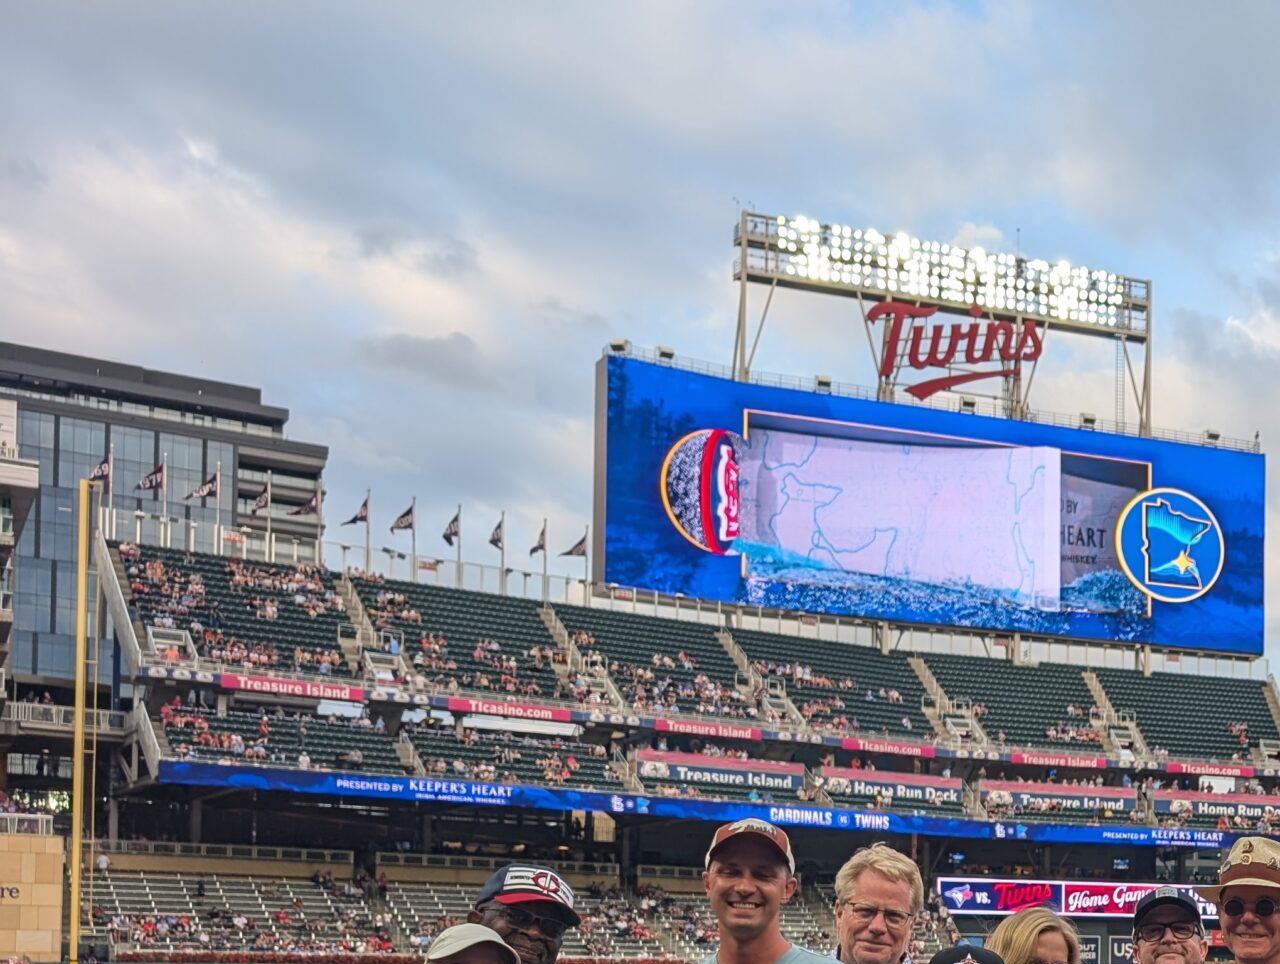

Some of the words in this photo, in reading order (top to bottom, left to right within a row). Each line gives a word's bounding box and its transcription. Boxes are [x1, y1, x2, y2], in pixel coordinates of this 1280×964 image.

[867, 302, 1043, 377] Twins
[1066, 499, 1079, 514] BY
[237, 677, 303, 695] Treasure
[307, 682, 350, 699] Island
[667, 720, 717, 736] Treasure
[718, 728, 751, 739] Island
[1022, 753, 1065, 767] Treasure
[1067, 756, 1097, 768] Island
[677, 766, 744, 785] Treasure
[748, 772, 792, 789] Island
[336, 779, 390, 792] PRESENTED
[391, 784, 404, 793] BY
[410, 780, 468, 794] KEEPER'S
[472, 784, 513, 797] HEART
[897, 784, 922, 798] Run
[1198, 802, 1235, 815] Home
[1237, 805, 1262, 816] Run
[770, 807, 833, 825] CARDINALS
[855, 814, 889, 830] TWINS
[1194, 831, 1224, 842] HEART
[975, 893, 991, 905] VS.
[1068, 889, 1110, 912] Home
